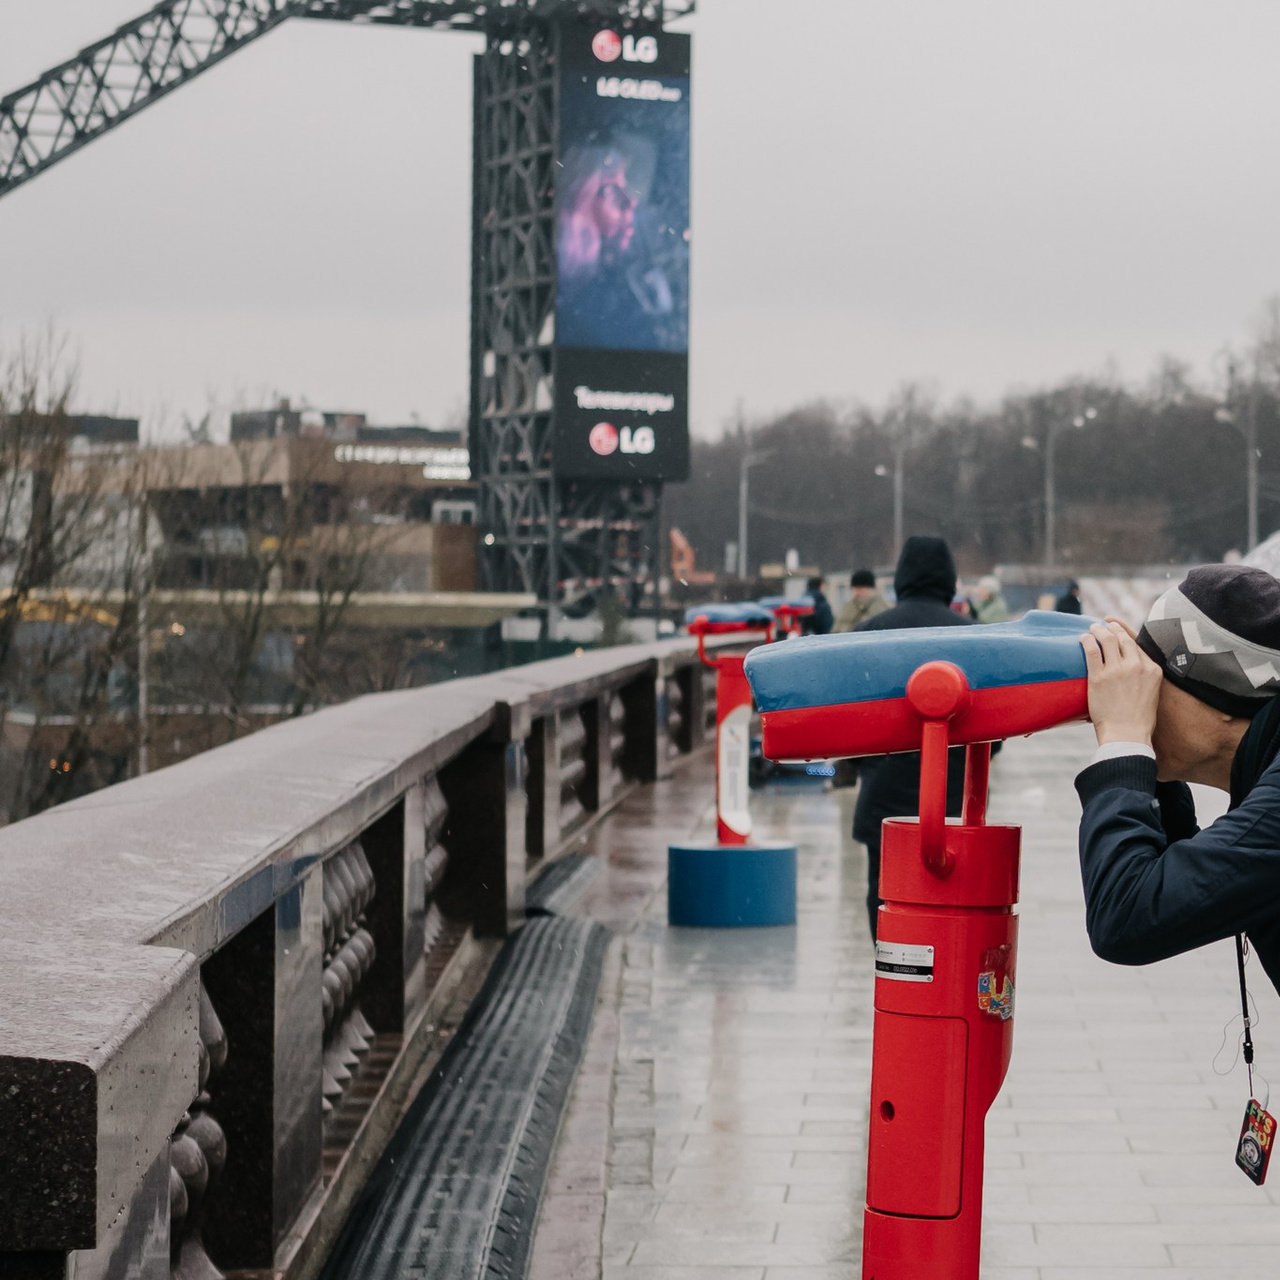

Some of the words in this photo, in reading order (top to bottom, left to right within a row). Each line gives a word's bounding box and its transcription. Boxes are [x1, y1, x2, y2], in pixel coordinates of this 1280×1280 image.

[622, 34, 658, 63] LG
[620, 426, 655, 454] LG
[1246, 1103, 1273, 1134] ET'S
